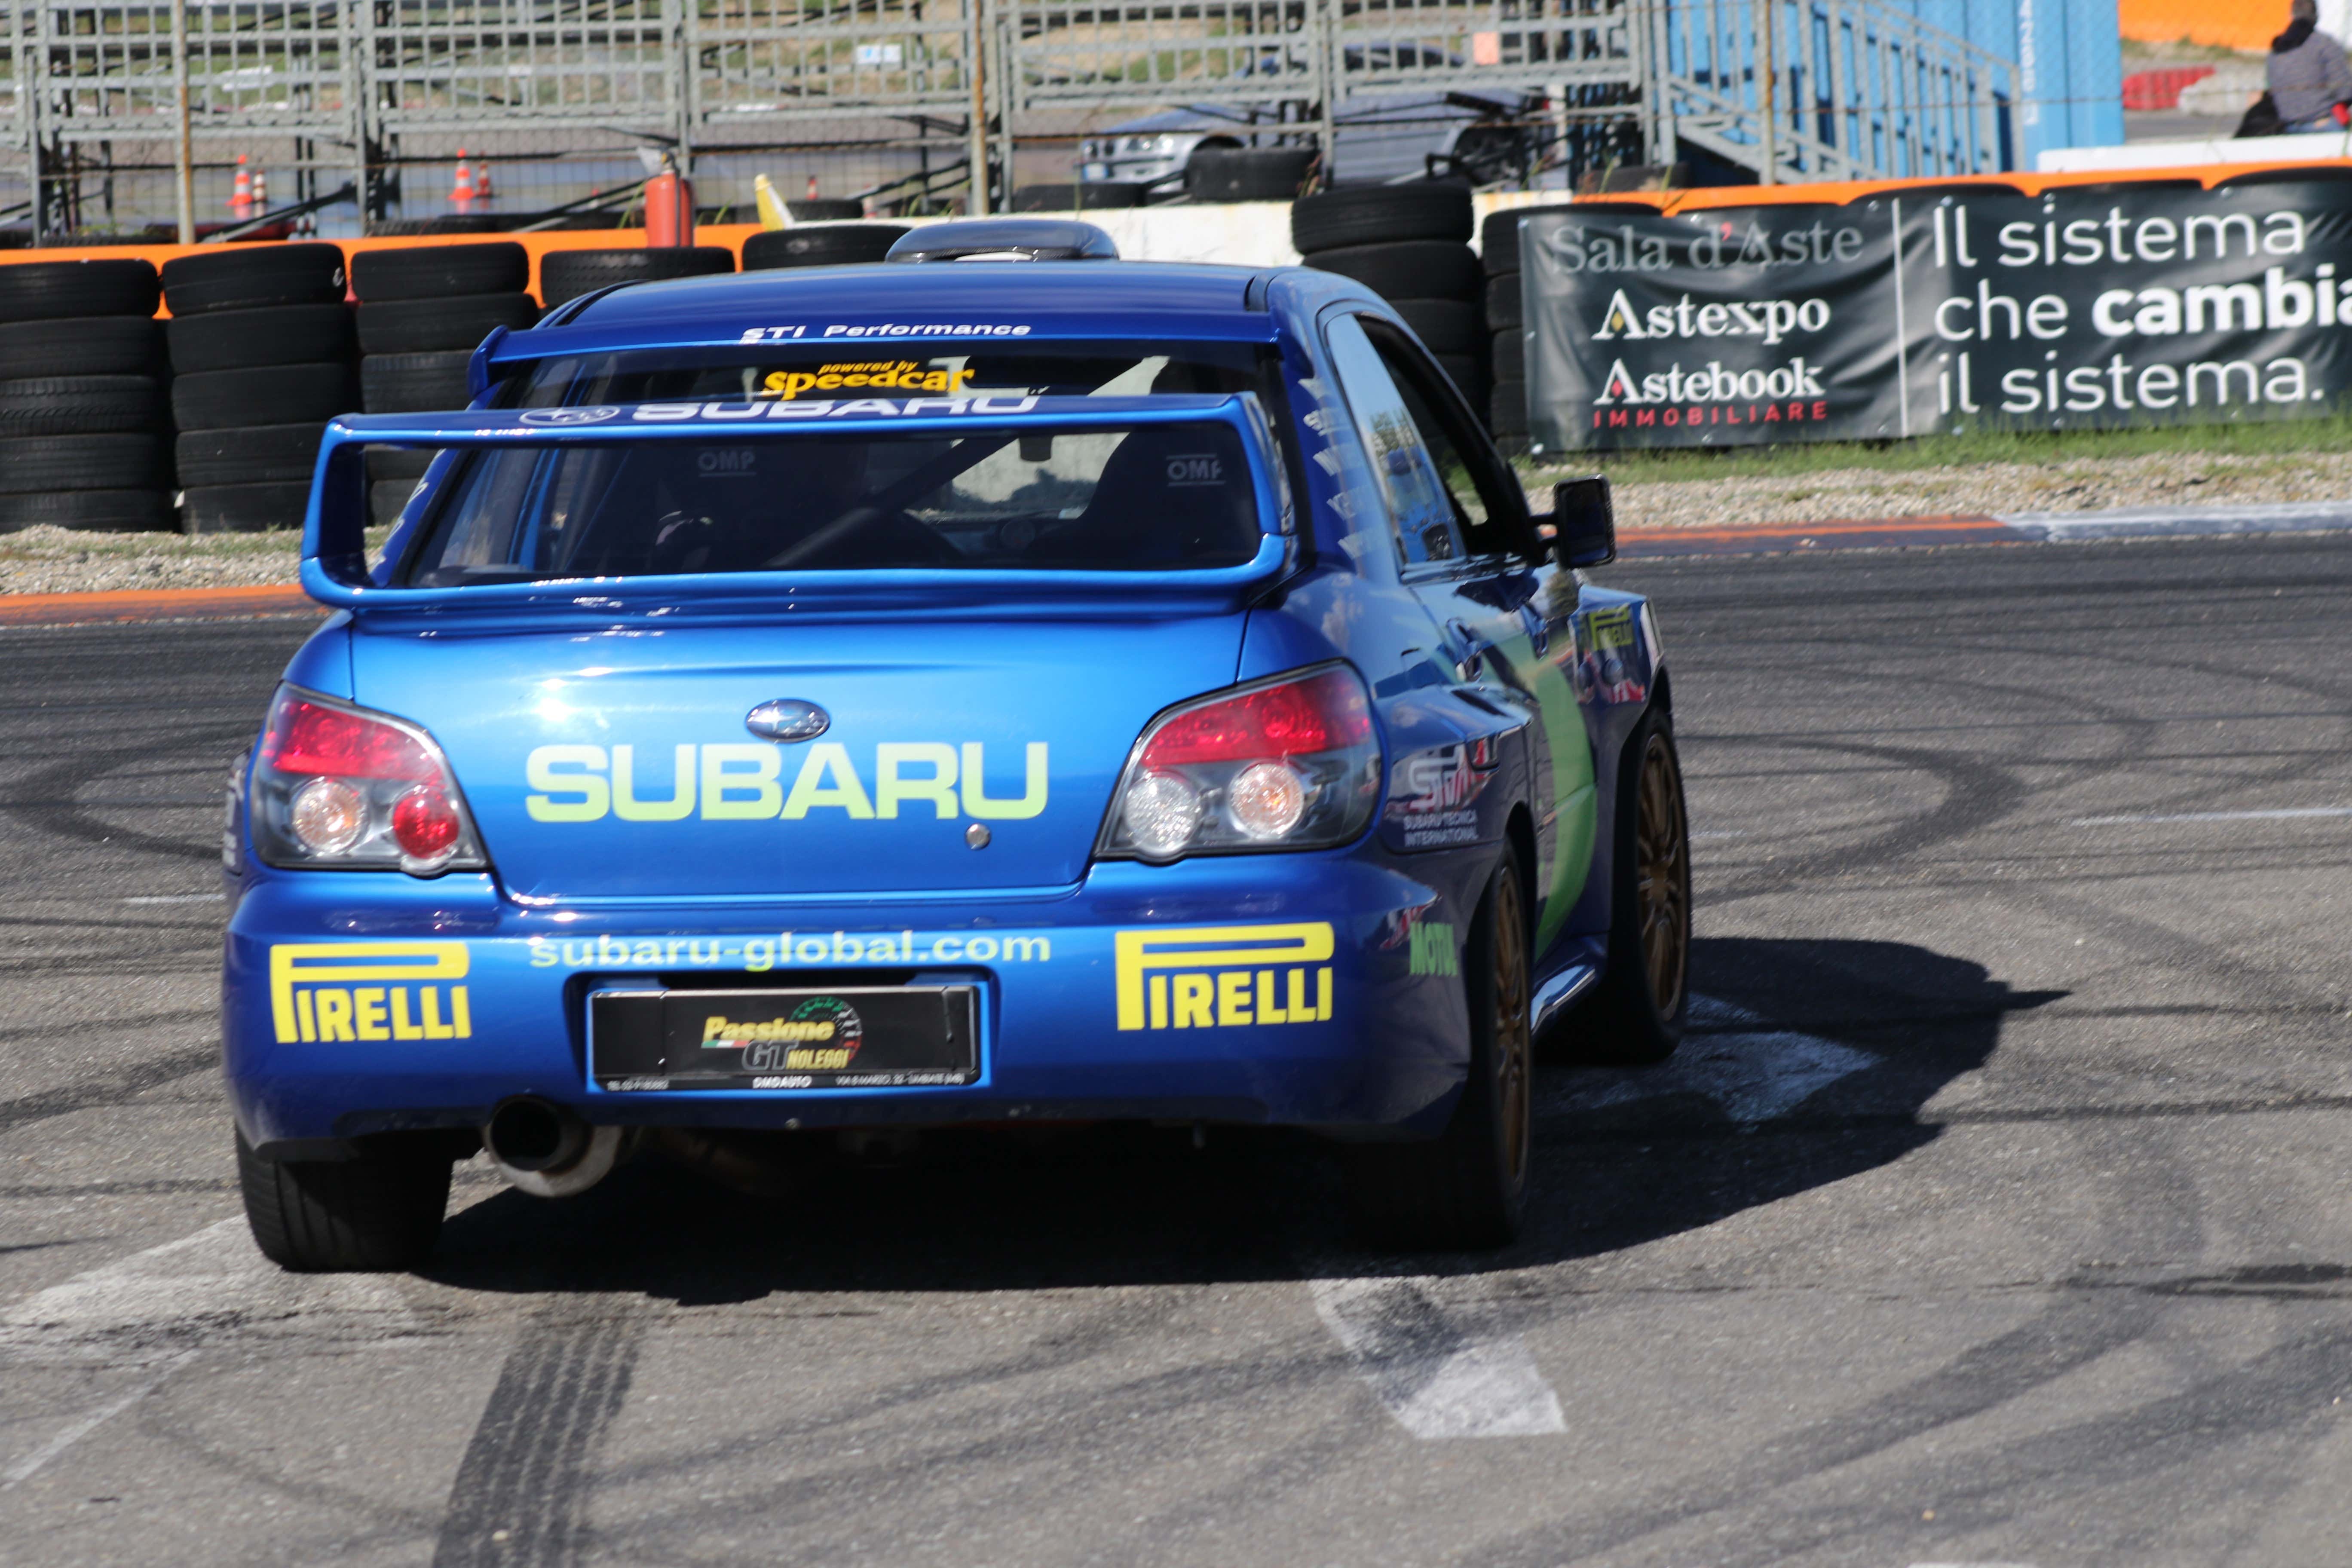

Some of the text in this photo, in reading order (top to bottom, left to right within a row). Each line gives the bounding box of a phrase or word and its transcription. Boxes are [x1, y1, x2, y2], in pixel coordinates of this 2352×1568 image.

[1552, 221, 1863, 274] Sala d'Aste
[1933, 202, 2305, 268] Il sistema
[741, 324, 1031, 340] STI Performance
[1591, 288, 1831, 344] Astexpo
[1934, 279, 2069, 342] che
[762, 367, 975, 401] speedcar
[818, 360, 919, 375] powered by
[1593, 357, 1827, 406] Astebook
[1938, 350, 2324, 414] il sistema.
[632, 395, 1040, 421] SUBARU
[1593, 401, 1828, 429] IMMOBILIARE
[698, 450, 756, 471] OMP
[526, 741, 1048, 822] SUBARU
[529, 930, 1050, 972] subaru-global.com
[270, 942, 472, 1044] PIRELLI
[1115, 922, 1335, 1031] PIRELLI
[703, 1016, 836, 1042] Passione
